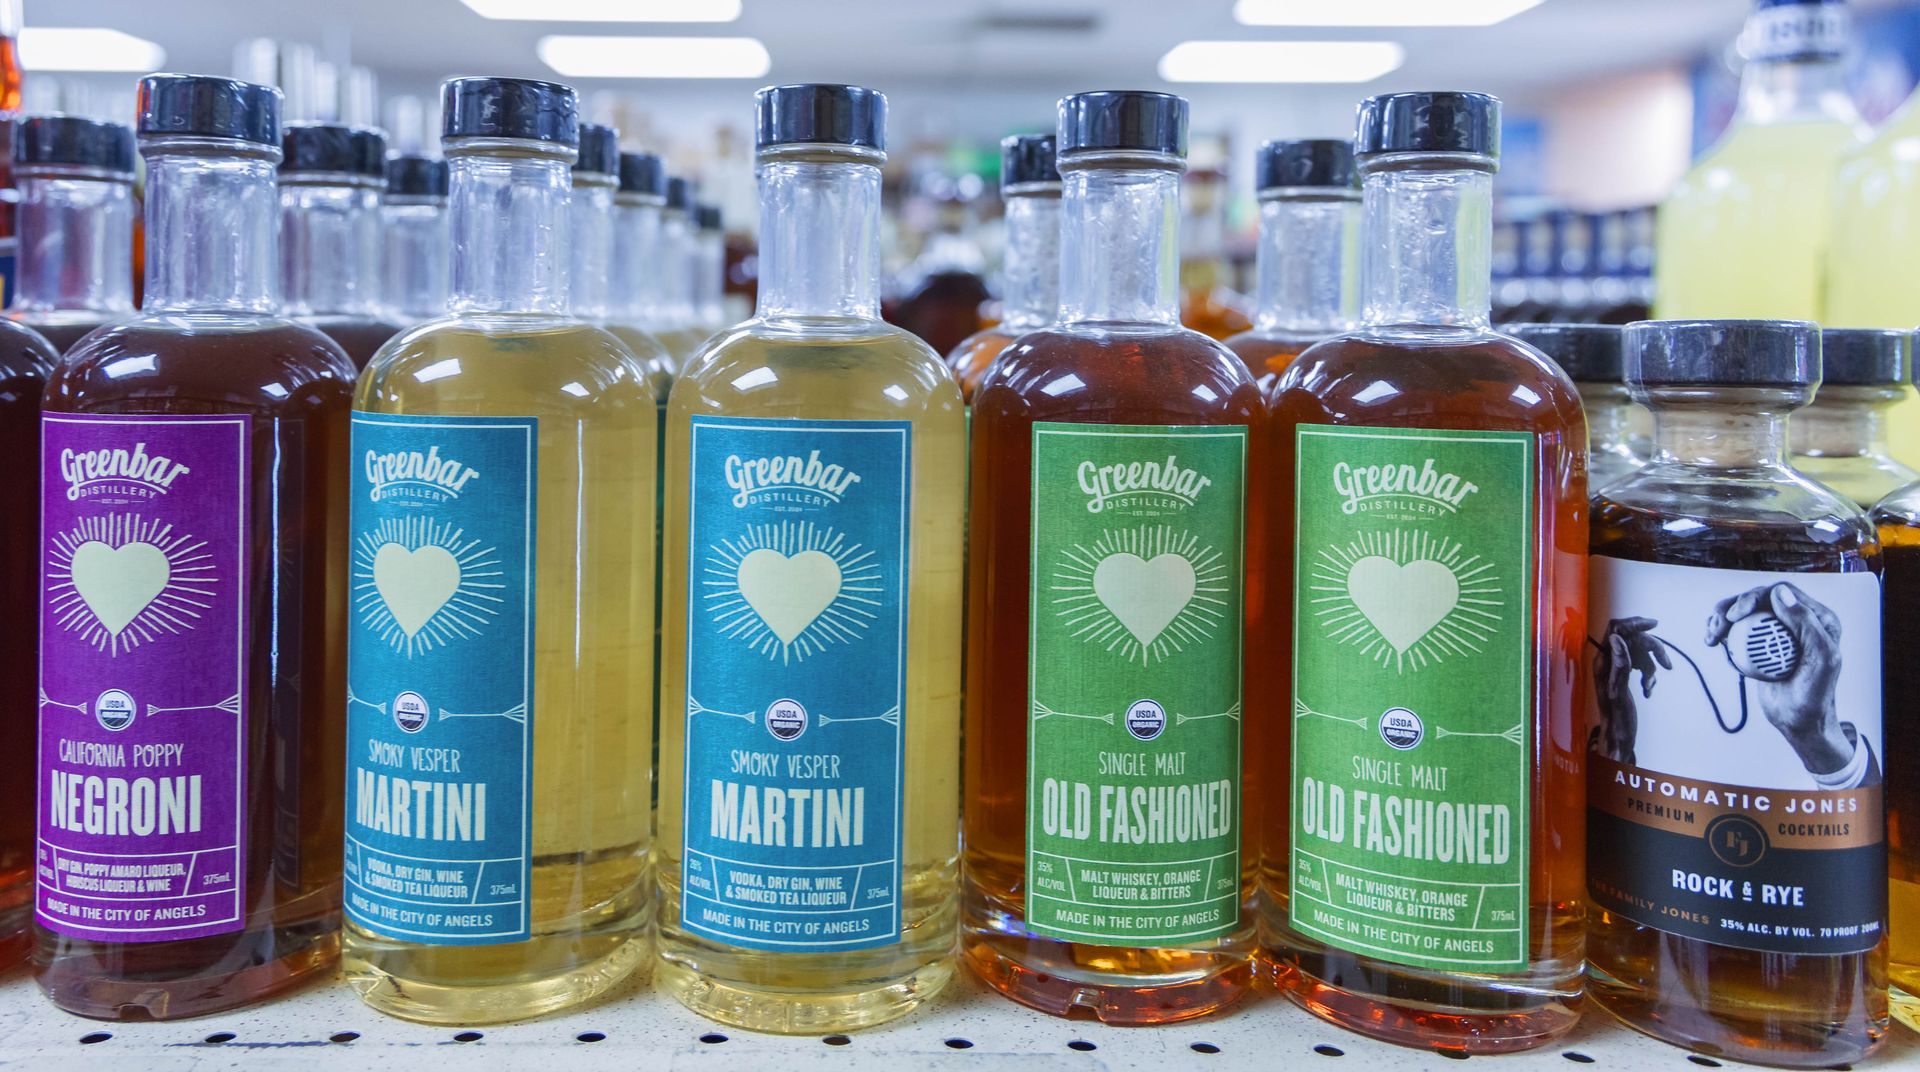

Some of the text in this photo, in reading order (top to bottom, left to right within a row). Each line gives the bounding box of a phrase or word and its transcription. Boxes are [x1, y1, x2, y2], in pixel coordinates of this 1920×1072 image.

[61, 443, 190, 500] Greenbar
[365, 446, 480, 502] Greenbar
[725, 450, 861, 508] Greenbar
[81, 485, 157, 498] DISTILLERY
[381, 487, 448, 502] DISTILLERY
[1077, 455, 1211, 513] Greenbar
[1333, 458, 1479, 515] Greenbar
[750, 493, 831, 507] DISTILLERY
[1106, 498, 1186, 511] DISTILLERY
[1360, 500, 1447, 517] DISTILLERY
[776, 710, 798, 719] USDA
[1136, 710, 1156, 718] USDA
[1390, 717, 1413, 728] USDA
[59, 738, 184, 767] CALIFORNIA POPPY
[369, 739, 461, 773] SMOKY VESPER
[731, 749, 840, 779] SMOKY VESPER
[1099, 752, 1186, 776] SINGLE MALT
[1352, 755, 1448, 791] SINGLE MALT
[51, 769, 202, 836] NEGRONI
[1614, 769, 1858, 814] AUTOMATIC JONES
[356, 767, 486, 841] MARTINI
[711, 779, 864, 847] MARTINI
[1043, 778, 1232, 844] OLD FASHIONED
[1626, 797, 1696, 825] PREMIUM
[1302, 776, 1510, 865] OLD FASHIONED
[1777, 823, 1850, 836] COCKTAILS
[84, 863, 109, 877] POPPY
[110, 864, 142, 878] AMARO
[144, 863, 186, 876] LIQUEUR,
[367, 858, 394, 876] VODKA,
[395, 865, 413, 879] DRY
[414, 868, 434, 883] GIN,
[436, 870, 464, 883] WINE
[1037, 861, 1053, 874] 35%
[1081, 870, 1201, 886] MALT WHISKEY, ORANGE
[99, 879, 136, 892] LIQUEUR
[137, 880, 145, 892] &
[146, 879, 171, 891] WINE
[365, 872, 468, 898] & SMOKED TEA LIQUEUR
[729, 871, 843, 891] VODKA, DRY GIN, WINE
[1037, 877, 1066, 892] ALC/VOL
[1092, 885, 1191, 900] LIQUEUR & BITTERS
[1336, 873, 1468, 907] MALT WHISKEY, ORANGE
[1672, 869, 1804, 907] ROCK & RYE
[725, 885, 847, 905] & SMOKED TEA LIQUEUR
[1346, 892, 1455, 922] LIQUEUR & BITTERS
[47, 898, 206, 921] MADE IN THE CITY OF ANGELS
[351, 892, 493, 926] MADE IN THE CITY OF ANGELS
[703, 908, 870, 934] MADE IN THE CITY OF ANGELS
[1056, 909, 1220, 928] MADE IN THE CITY OF ANGELS
[1491, 911, 1516, 921] 375mL
[1661, 905, 1710, 925] JONES
[1314, 909, 1494, 952] MADE IN THE CITY OF ANGELS
[1720, 919, 1815, 937] 35% ALC. BY VOL.
[1820, 928, 1831, 937] 70
[1834, 926, 1858, 936] PROOF
